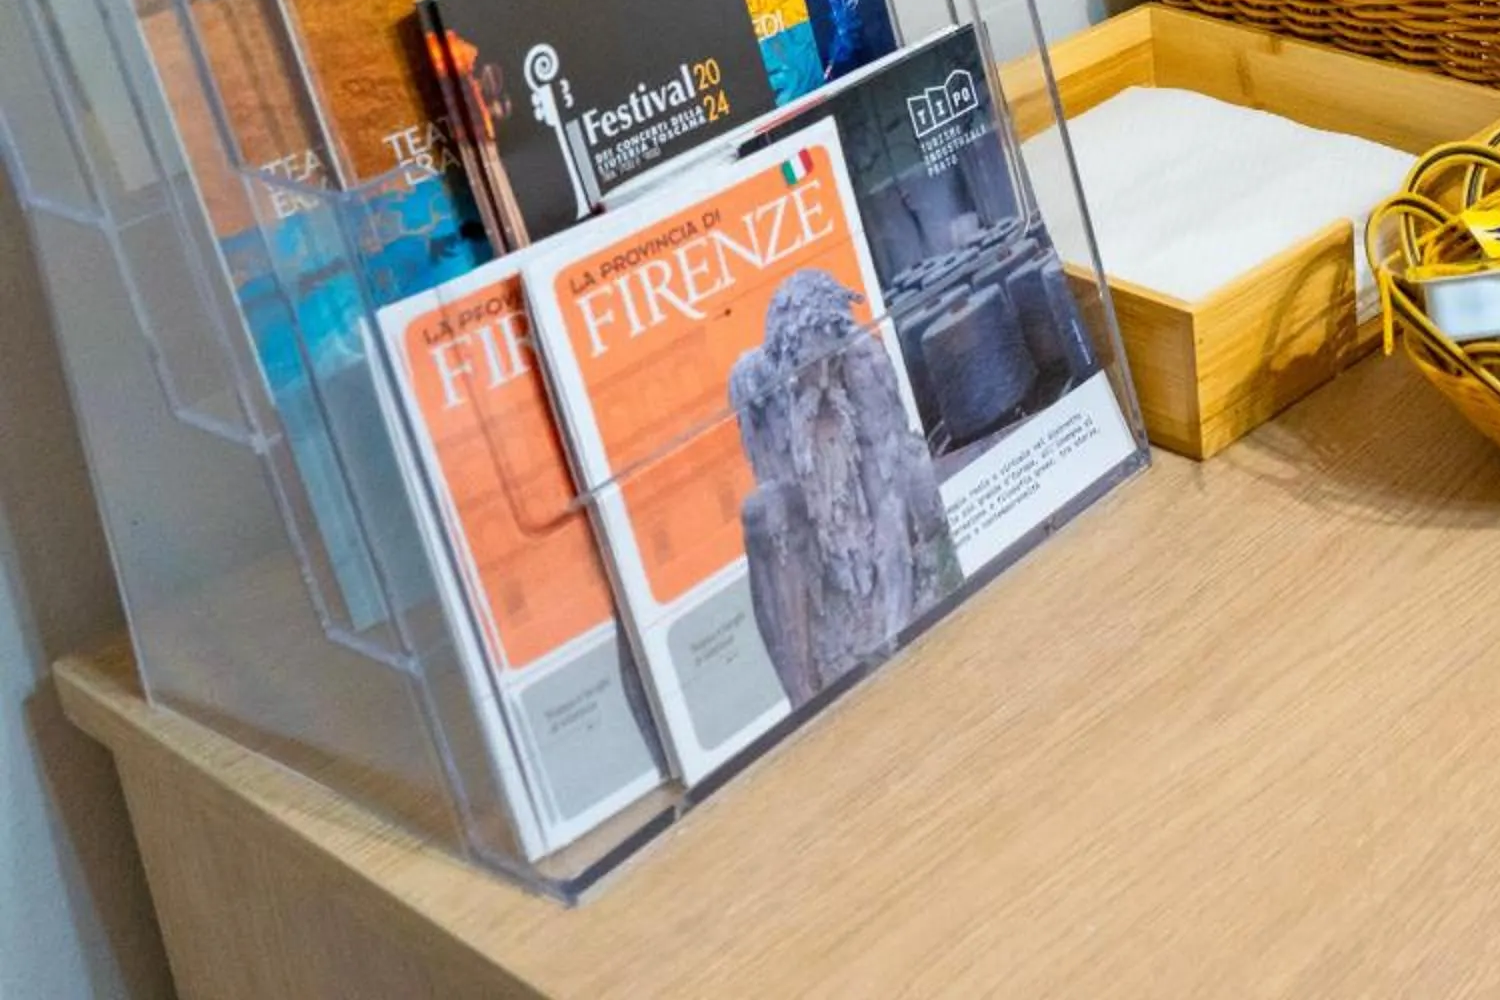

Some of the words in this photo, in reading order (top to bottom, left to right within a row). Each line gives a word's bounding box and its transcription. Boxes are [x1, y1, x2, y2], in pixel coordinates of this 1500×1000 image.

[582, 64, 696, 147] Festival
[916, 87, 971, 125] TIPO
[569, 271, 595, 294] LA
[599, 220, 698, 278] PROVINCIA
[702, 209, 722, 231] DI
[572, 180, 836, 358] FIRENZE
